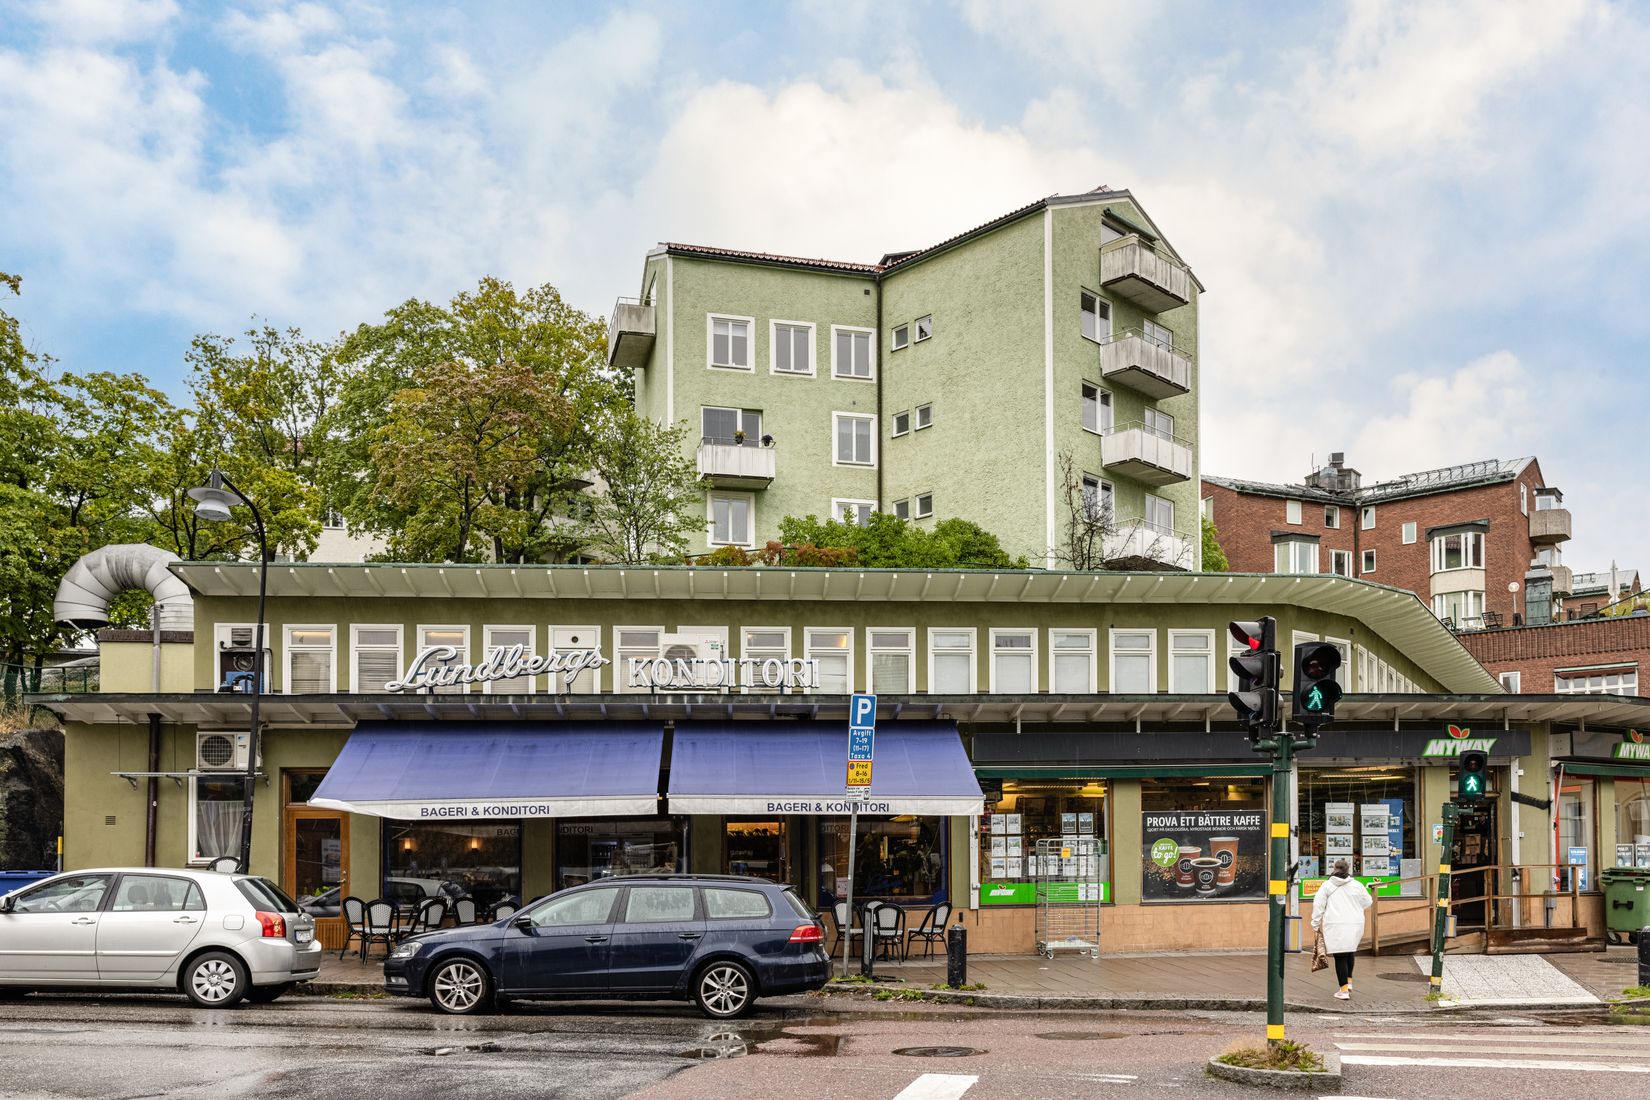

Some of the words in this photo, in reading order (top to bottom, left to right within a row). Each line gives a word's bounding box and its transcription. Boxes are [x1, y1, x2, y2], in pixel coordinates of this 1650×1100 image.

[384, 643, 611, 692] Lundbergs
[628, 657, 820, 688] KONDITORI
[857, 698, 872, 725] P
[1423, 738, 1498, 756] MYWAY
[421, 806, 468, 817] BAGERI
[471, 806, 480, 816] &
[483, 805, 550, 816] KONDITORI
[767, 803, 812, 812] BAGERI
[814, 803, 823, 812] &
[1147, 816, 1178, 827] PROVA
[1180, 816, 1195, 826] ETT
[1198, 813, 1231, 826] BÄTTRE
[1233, 815, 1260, 826] KAFFE
[1153, 847, 1163, 858] to
[1164, 846, 1178, 864] go!
